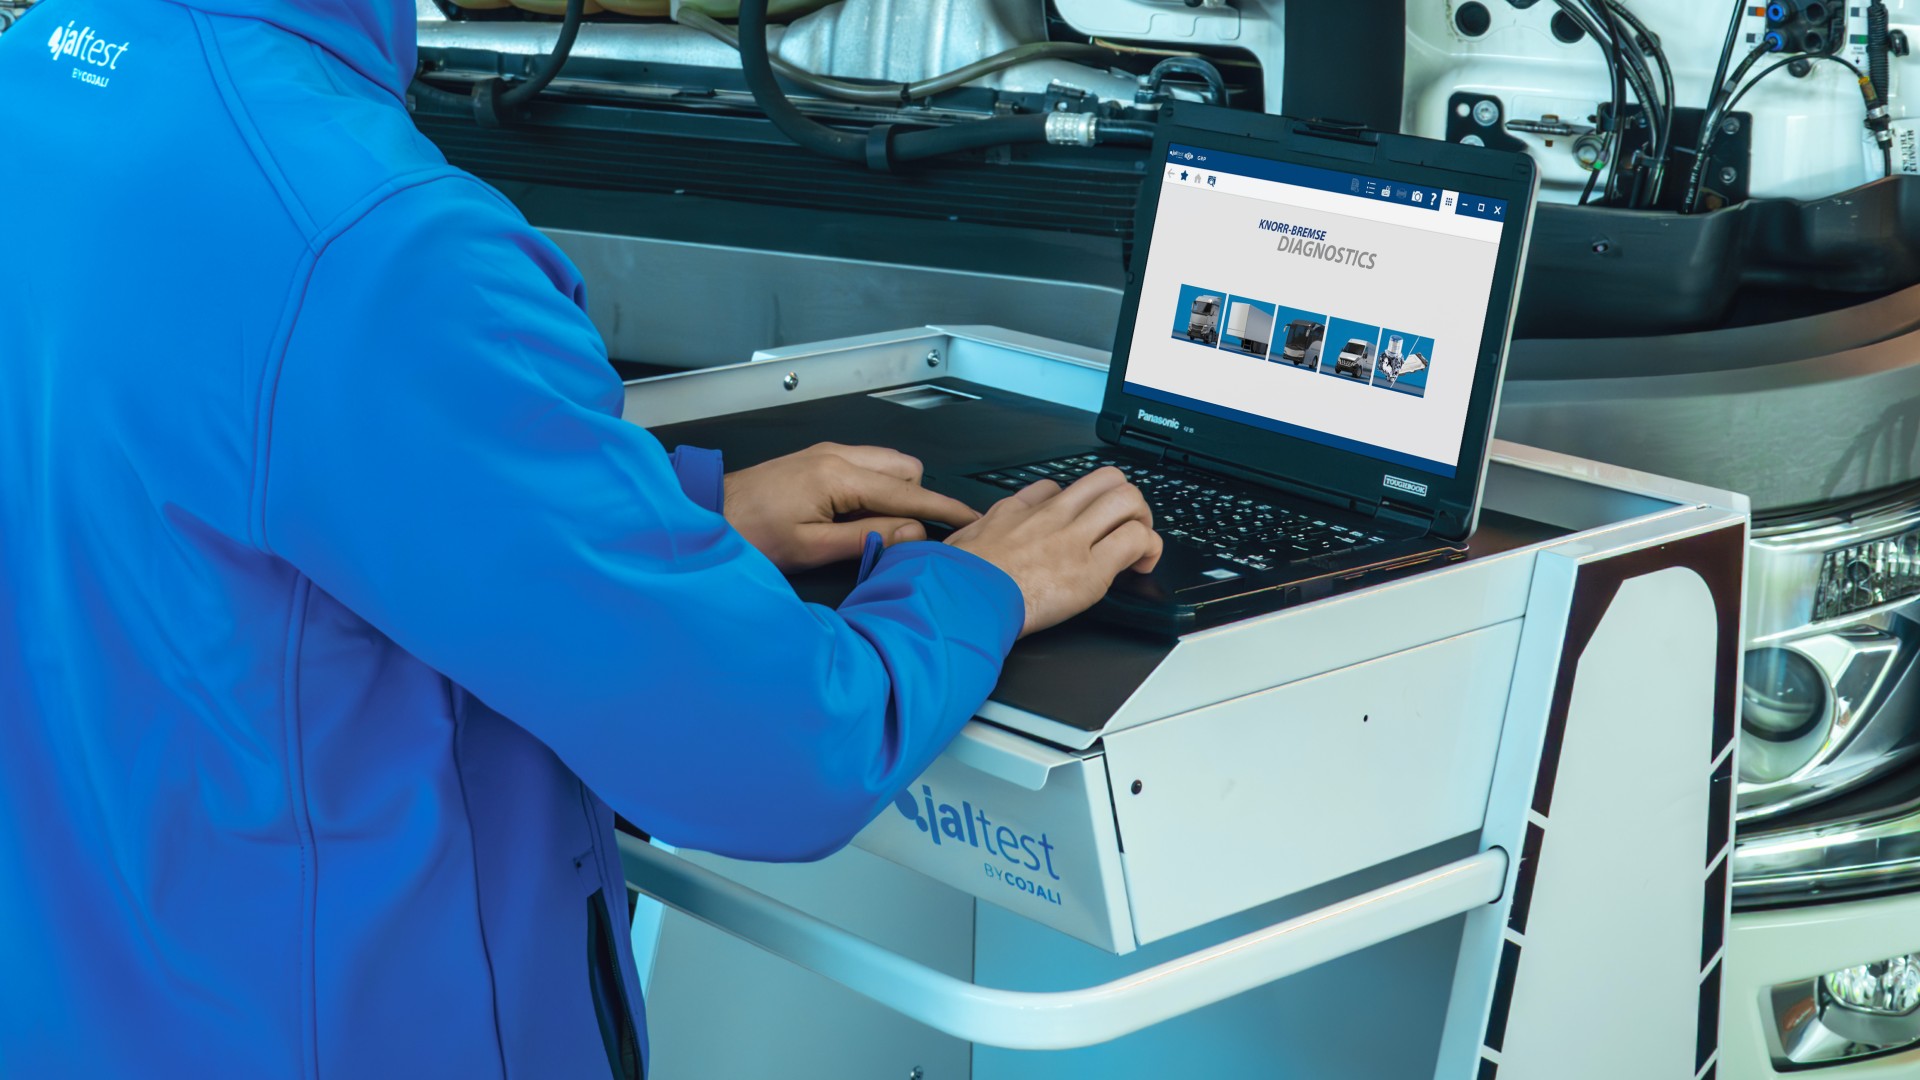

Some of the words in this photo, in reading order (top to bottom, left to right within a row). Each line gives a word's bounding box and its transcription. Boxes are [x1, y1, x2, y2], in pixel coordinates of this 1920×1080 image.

[1258, 219, 1327, 242] KNORR-BREMSE
[1276, 235, 1378, 270] DIAGNOSTICS
[1137, 408, 1180, 430] Panasonic
[921, 784, 1060, 881] jaltest
